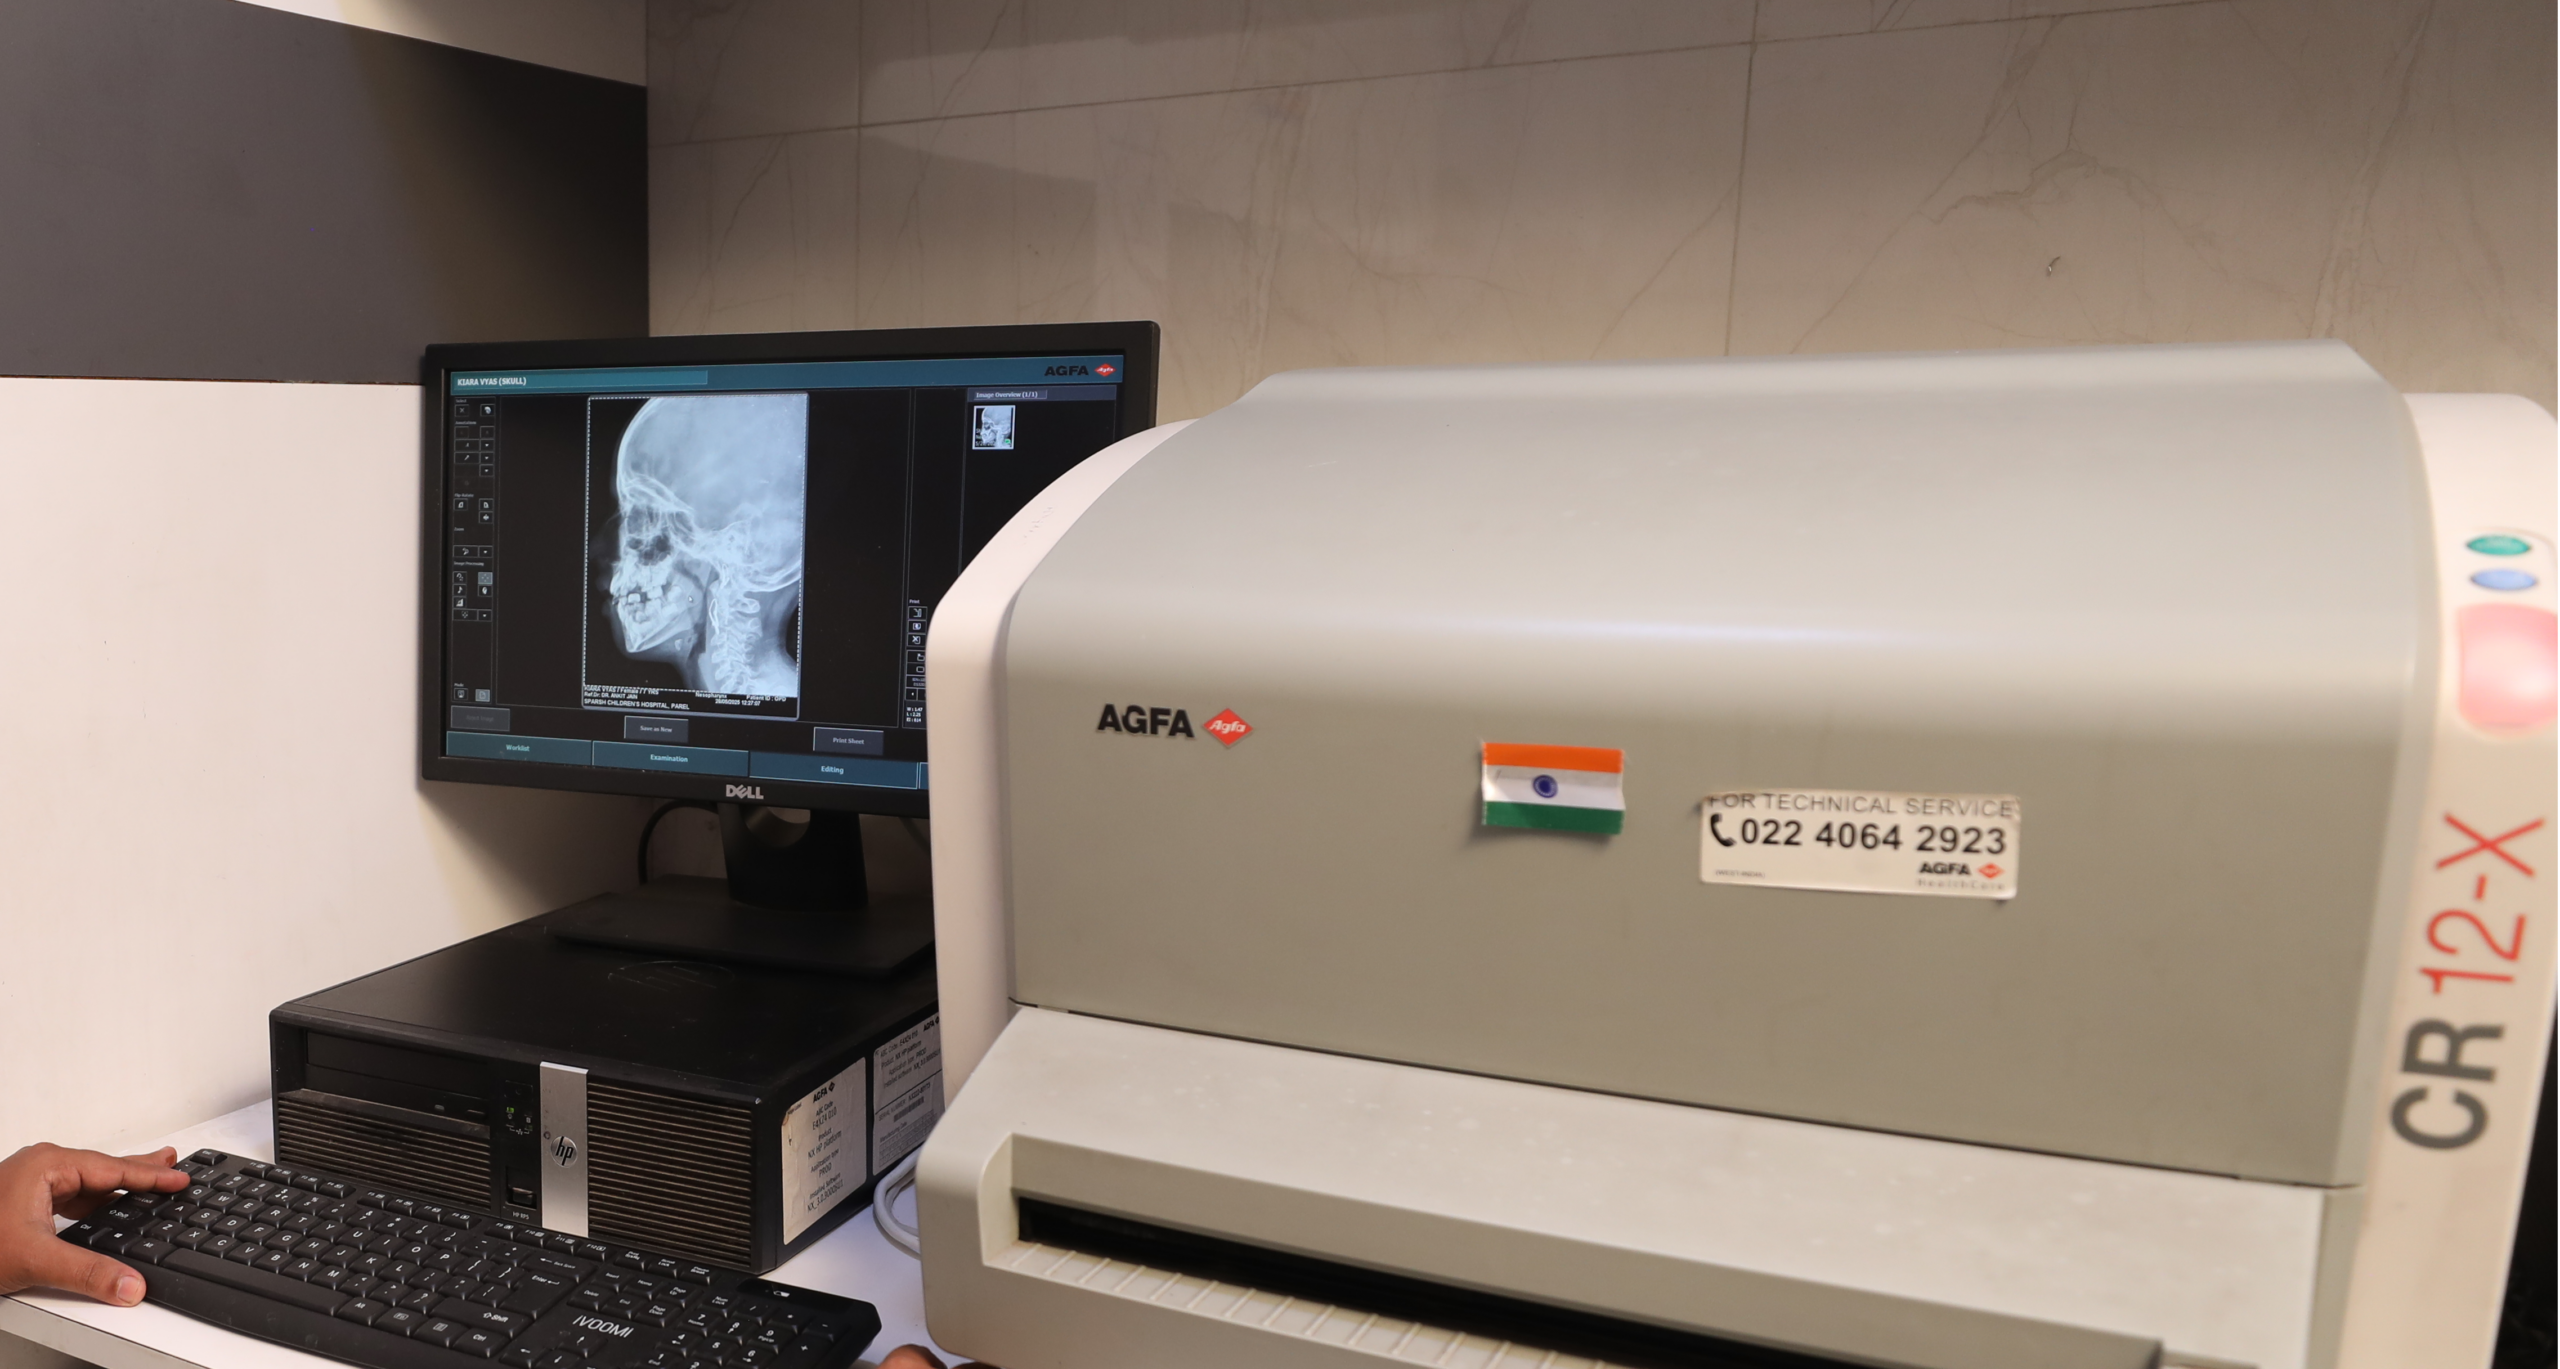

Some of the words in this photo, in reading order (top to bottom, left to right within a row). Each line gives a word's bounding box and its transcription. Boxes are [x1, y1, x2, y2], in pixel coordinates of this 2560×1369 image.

[1044, 365, 1089, 376] AGFA
[457, 378, 479, 386] KIARA
[480, 378, 498, 386] VYAS
[499, 377, 527, 386] (SKULL)
[1097, 703, 1195, 738] AGFA
[1209, 719, 1247, 735] Agfa
[505, 744, 530, 752] Worklist
[650, 754, 688, 762] Examination
[821, 765, 844, 775] Editing
[726, 784, 764, 799] DELL
[1761, 793, 1897, 814] TECHNICAL
[1906, 797, 2014, 818] SERVICE
[1741, 818, 1803, 846] 022
[1815, 822, 1902, 851] 4064
[1916, 825, 2007, 855] 2923
[1919, 861, 1971, 876] AGFA
[2419, 813, 2545, 996] 12-X
[2389, 1017, 2505, 1151] CR
[813, 1087, 828, 1103] AGFA
[824, 1101, 834, 1111] Code
[818, 1127, 832, 1141] Product
[824, 1130, 842, 1150] platform
[556, 1136, 573, 1166] hp
[811, 1154, 830, 1173] Application
[819, 1162, 832, 1178] PROD
[244, 1246, 254, 1254] V
[327, 1270, 340, 1278] M
[532, 1275, 548, 1283] Enter
[473, 1334, 487, 1342] Ctrl
